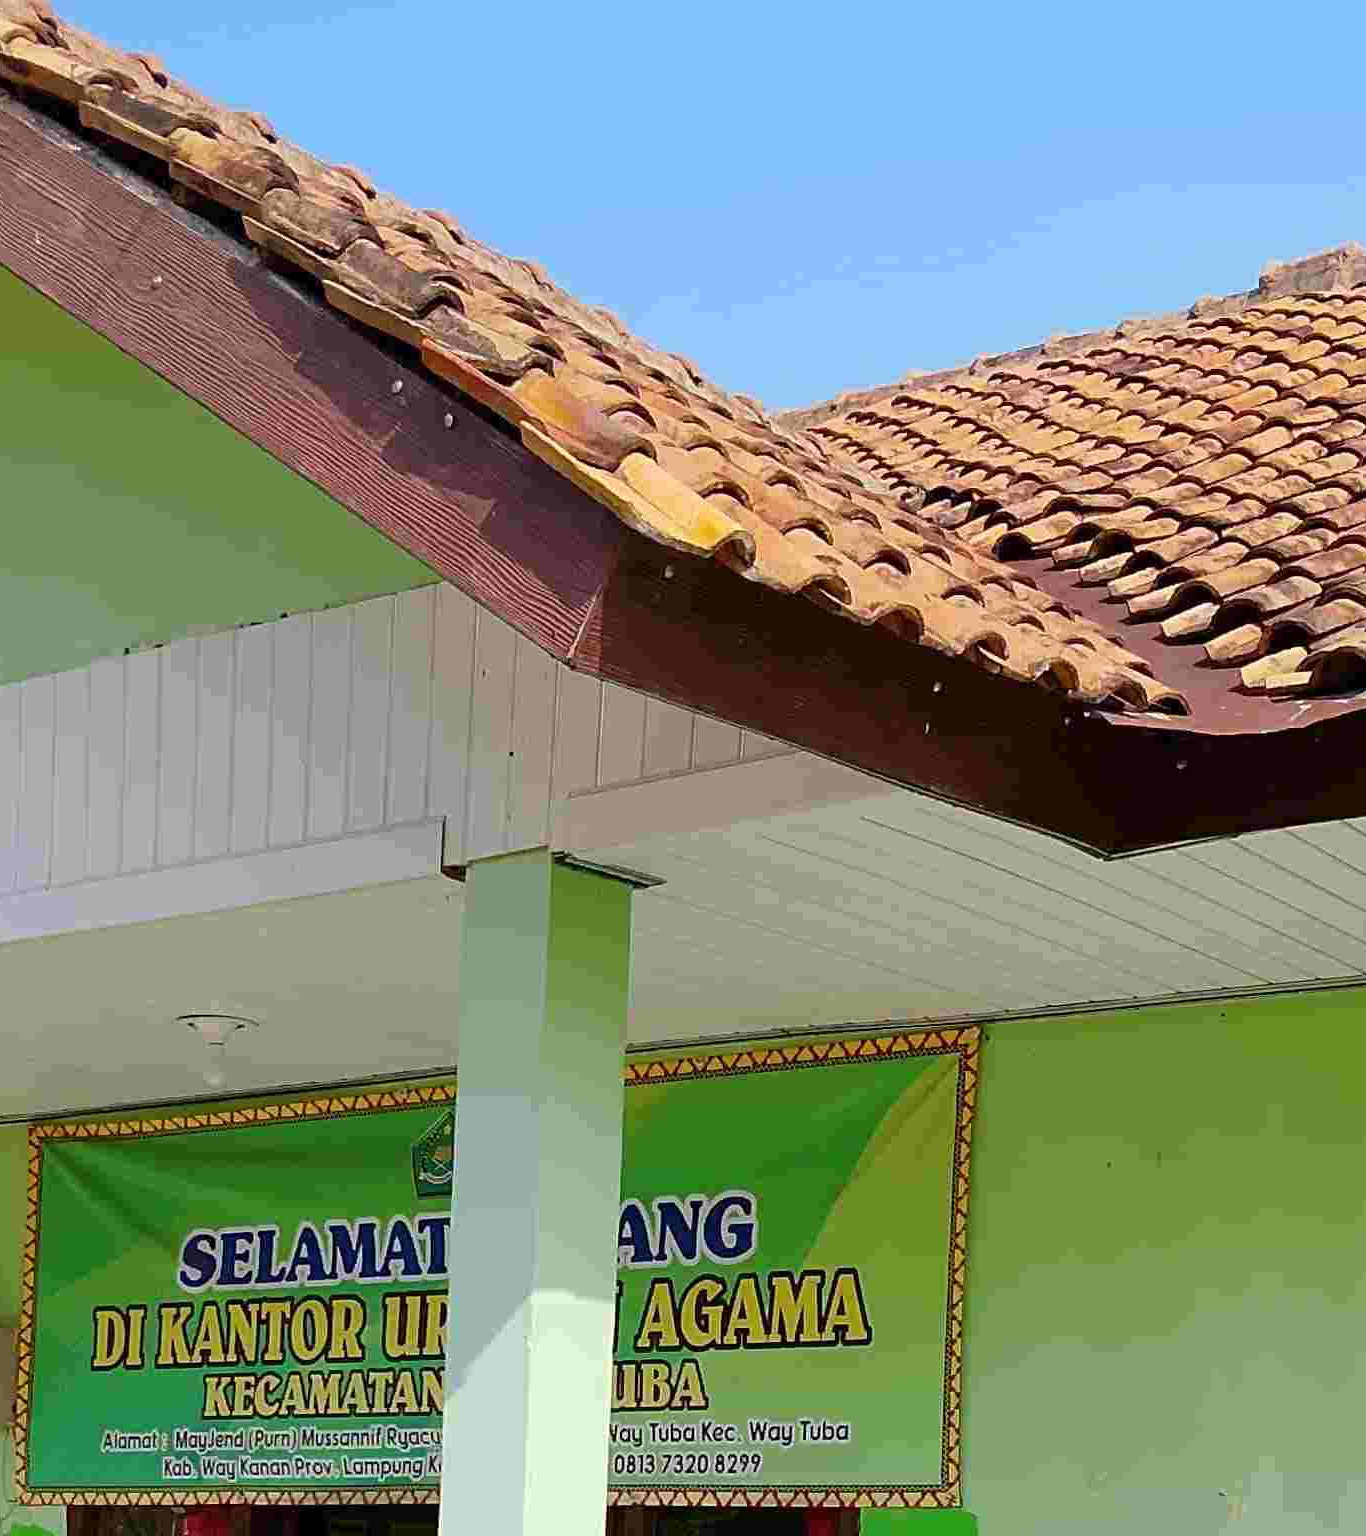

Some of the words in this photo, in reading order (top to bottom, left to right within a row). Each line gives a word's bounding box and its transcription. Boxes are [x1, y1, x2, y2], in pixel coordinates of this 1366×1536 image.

[179, 1215, 451, 1288] SELAMAT
[617, 1195, 755, 1263] ANG
[91, 1305, 147, 1370] DI
[155, 1295, 366, 1369] KANTOR
[634, 1267, 872, 1352] AGAMA
[609, 1358, 709, 1412] UBA
[103, 1431, 158, 1449] Alamat
[249, 1427, 297, 1451] (Purn)
[301, 1426, 382, 1447] Mussannif
[387, 1426, 442, 1450] Ryacu
[650, 1421, 695, 1441] Tuba
[749, 1420, 794, 1446] Way
[800, 1419, 849, 1441] Tuba
[202, 1458, 236, 1480] Way
[240, 1457, 291, 1476] Kanan
[343, 1456, 423, 1480] Lampung
[614, 1454, 656, 1473] 0813
[661, 1453, 709, 1473] 7320
[715, 1453, 762, 1473] 8299
